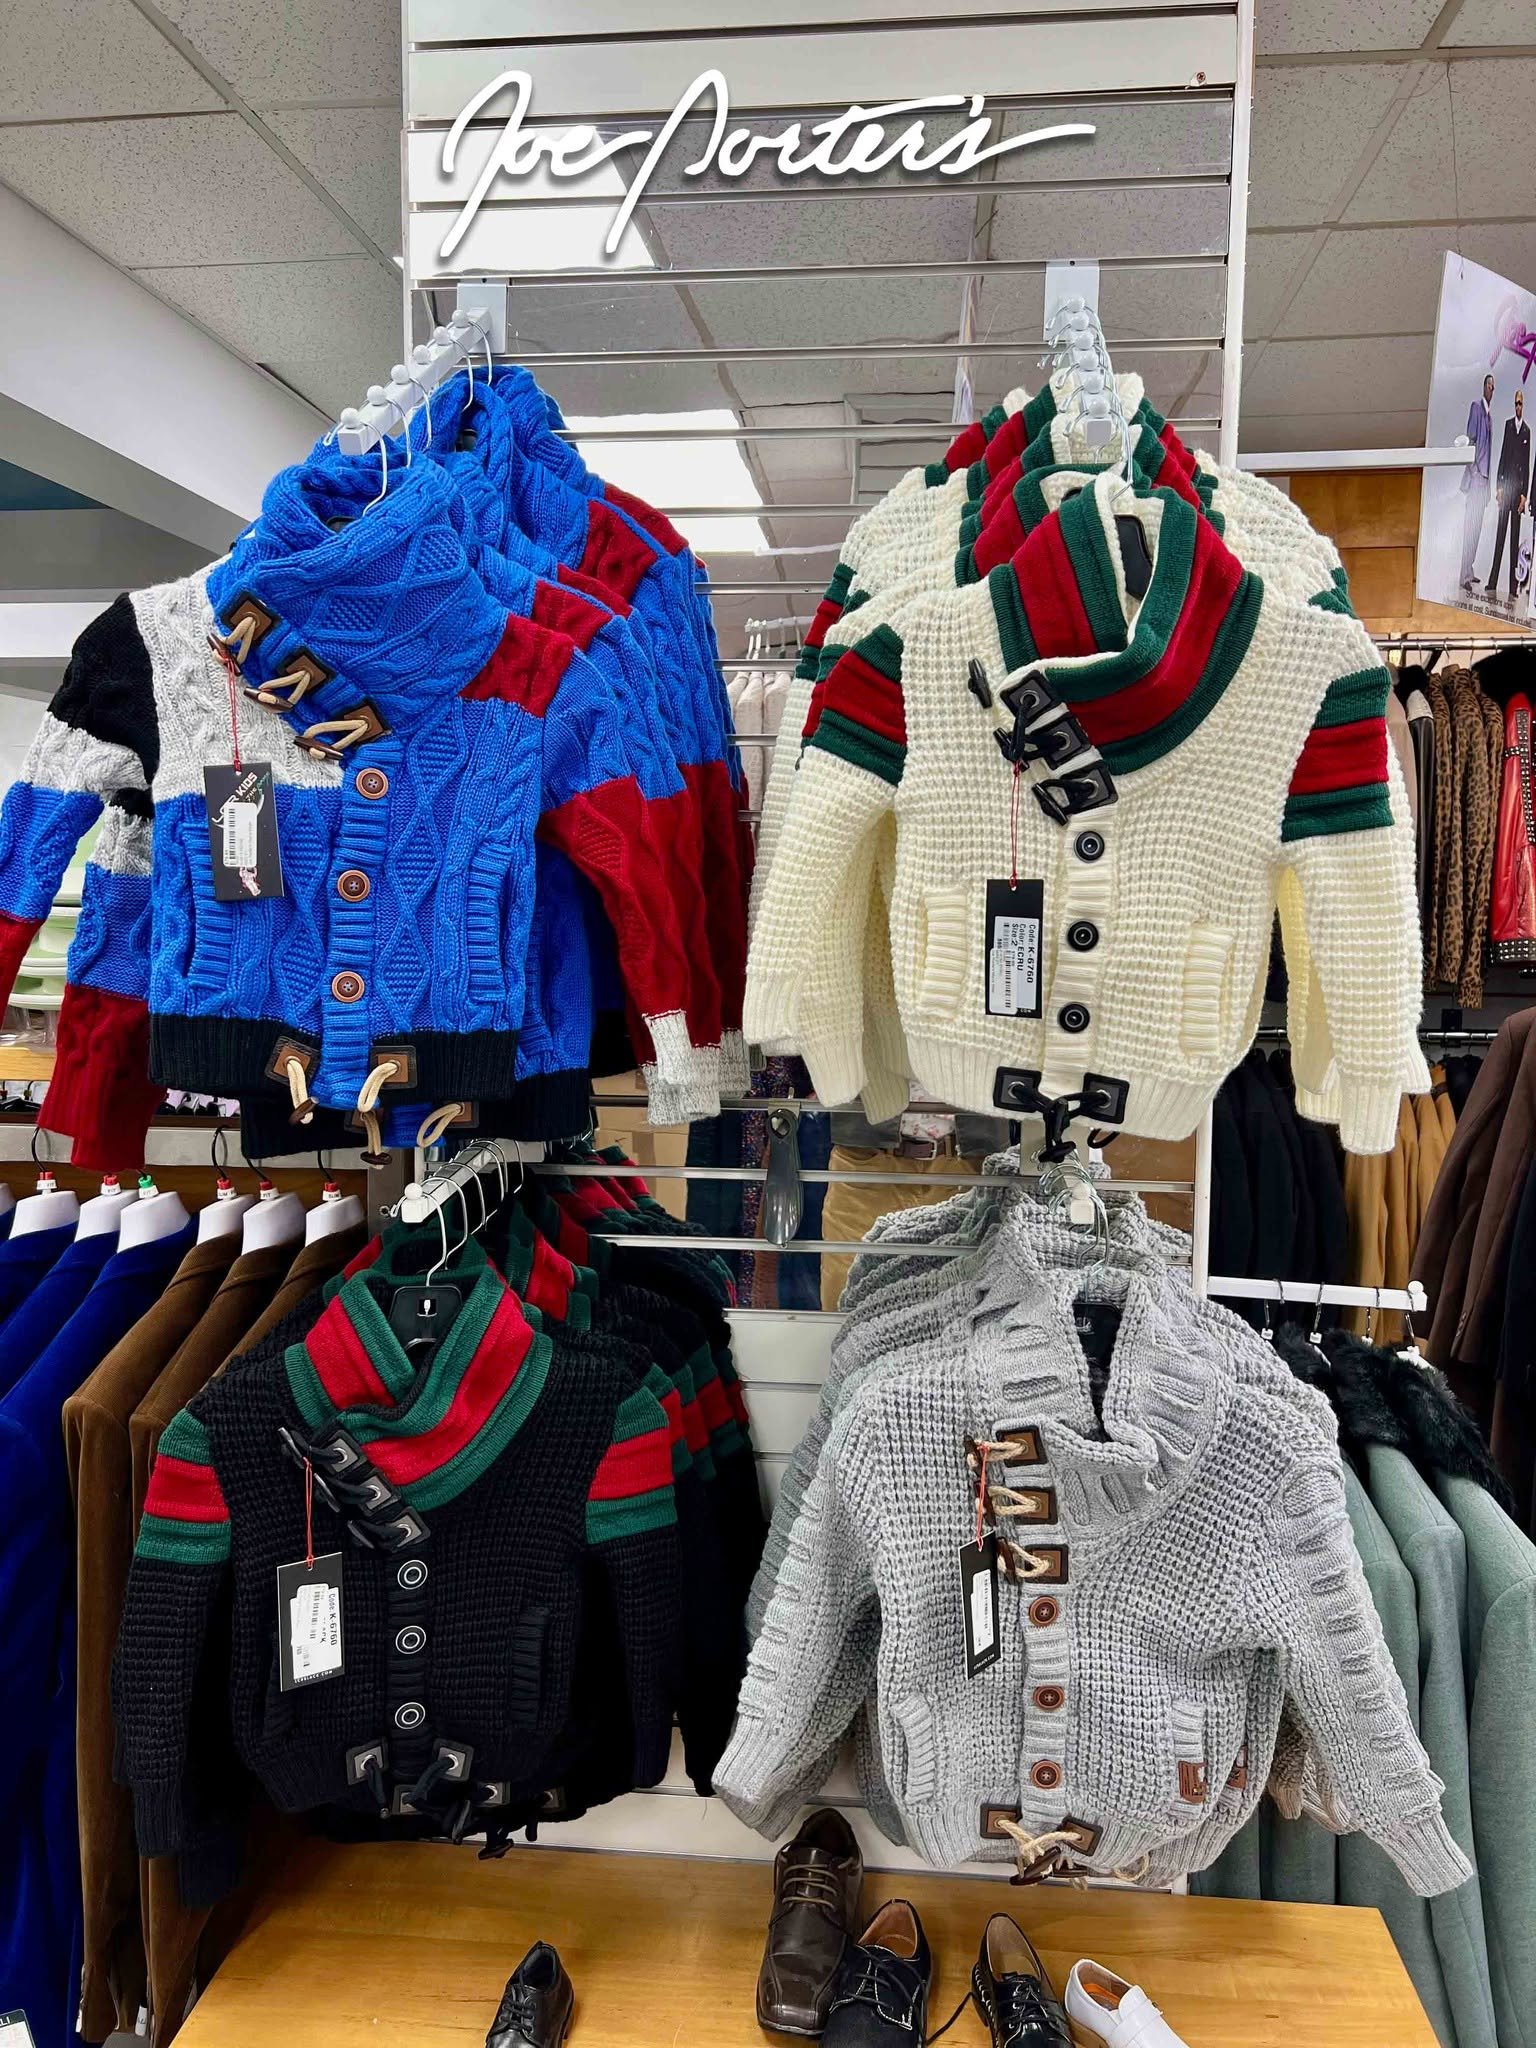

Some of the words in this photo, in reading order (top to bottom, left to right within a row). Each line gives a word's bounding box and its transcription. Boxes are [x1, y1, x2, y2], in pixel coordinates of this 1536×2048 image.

[236, 772, 258, 796] KIDS
[1018, 923, 1027, 945] Color:
[1028, 924, 1036, 945] Code:
[1016, 946, 1025, 971] ECRU
[1026, 946, 1035, 983] K-6760
[328, 1593, 336, 1613] Code:
[329, 1613, 338, 1646] K-6760
